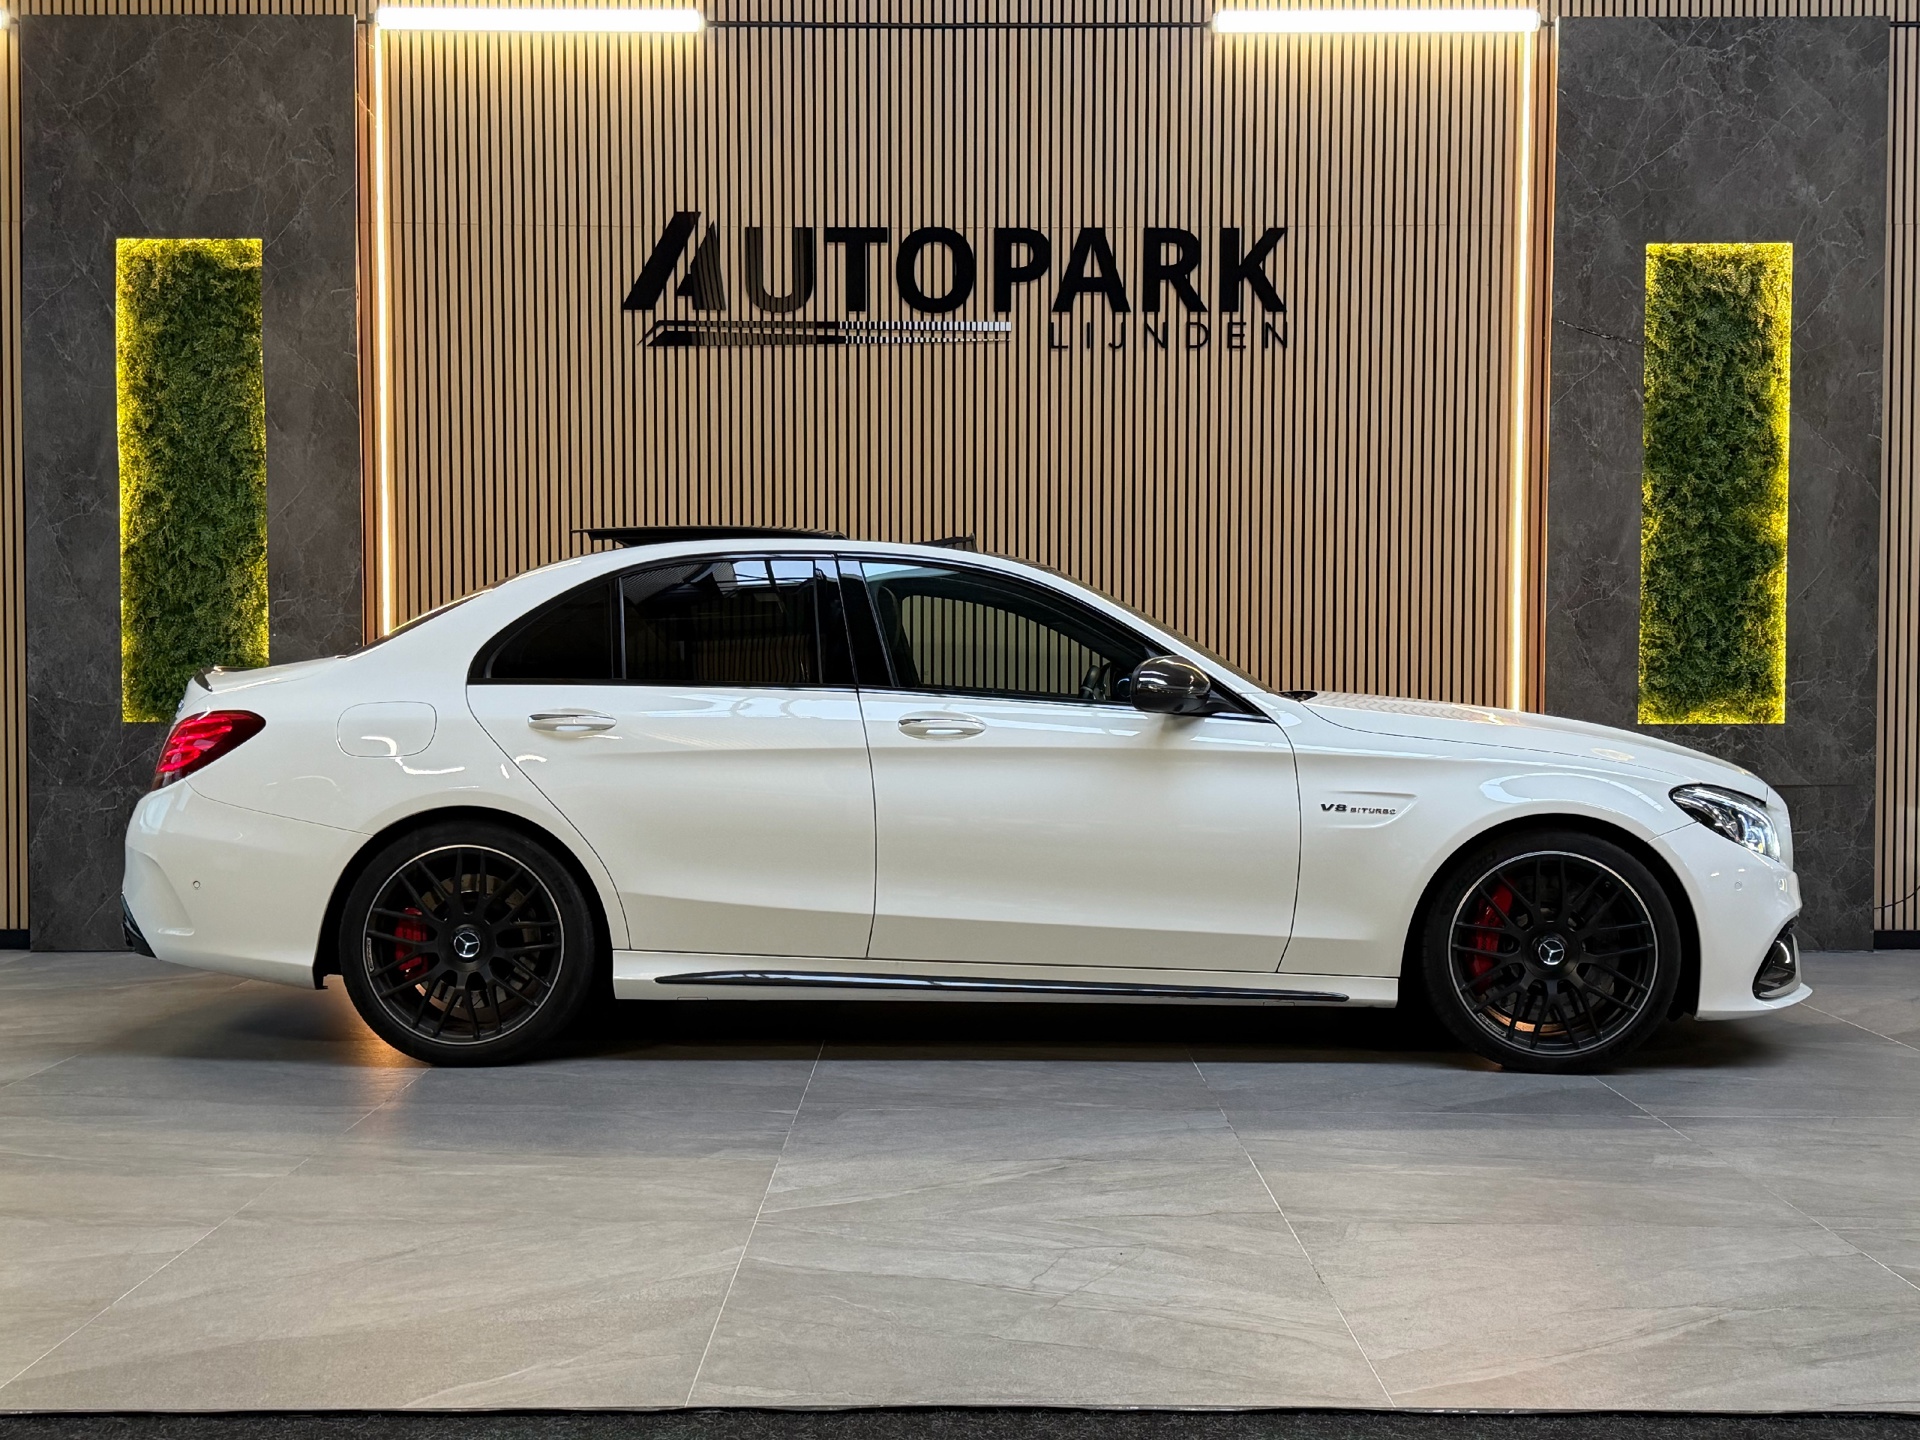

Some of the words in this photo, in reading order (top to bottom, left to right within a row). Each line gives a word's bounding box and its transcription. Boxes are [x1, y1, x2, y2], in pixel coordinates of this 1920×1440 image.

[623, 211, 1288, 314] AUTOPARK
[1050, 321, 1289, 350] LIJNDEN
[1320, 803, 1348, 813] V8
[1349, 806, 1397, 815] BITURBO
